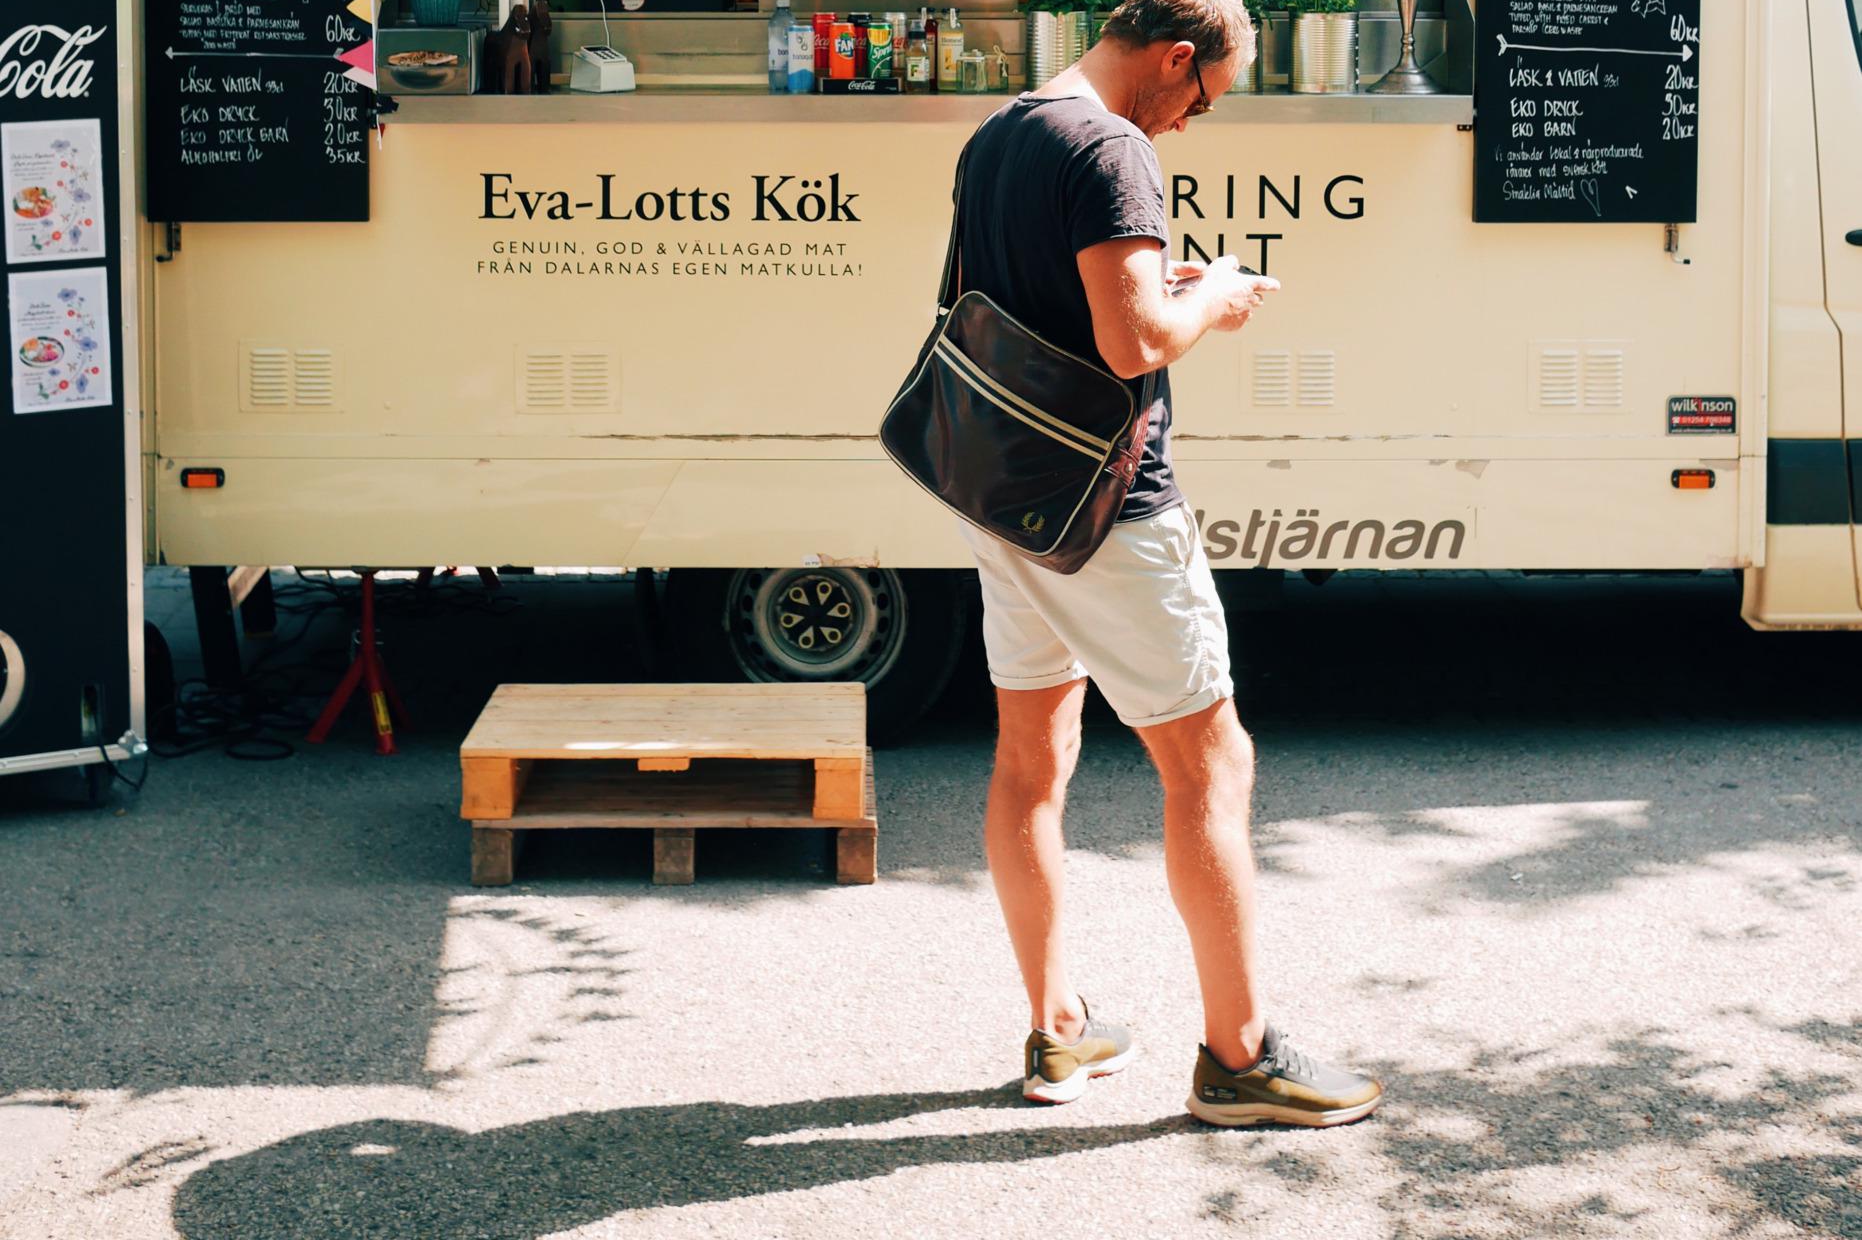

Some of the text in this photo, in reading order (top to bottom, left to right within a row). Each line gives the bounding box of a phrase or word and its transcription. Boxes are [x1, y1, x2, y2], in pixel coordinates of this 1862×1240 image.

[1510, 1, 1535, 11] SALLAD
[1534, 11, 1552, 23] WITH
[325, 14, 361, 43] 60KR
[1669, 14, 1699, 43] 60KR
[835, 38, 855, 54] FAN
[180, 65, 216, 93] LÄSK
[222, 67, 262, 93] VATTEN
[323, 71, 359, 94] 20KR
[1509, 55, 1543, 88] LÄSK
[1558, 62, 1599, 87] VATTEN
[1665, 64, 1698, 91] 20KR
[848, 80, 876, 93] Coca-Cola
[180, 104, 260, 125] EKO DRYCK
[323, 96, 359, 123] 30KR
[1510, 97, 1584, 118] EKO DRYCK
[1661, 94, 1698, 116] 30KR
[180, 127, 206, 145] EKO
[218, 127, 256, 145] DRYCK
[323, 123, 363, 146] 20KR
[1512, 116, 1577, 138] EKO BARN
[1662, 117, 1695, 141] 20KR
[325, 146, 366, 164] 35KR
[1538, 163, 1557, 178] med
[478, 172, 862, 222] Eva-Lotts Kök
[1171, 175, 1365, 220] RING
[492, 239, 848, 257] GENUIN, GOD & VÄLLAGAD MAT
[1183, 233, 1283, 277] NT
[477, 257, 863, 277] FRÅN DALARNAS EGEN MATKULLA!
[1671, 398, 1734, 413] wilkinson
[1194, 509, 1466, 568] stjärnan
